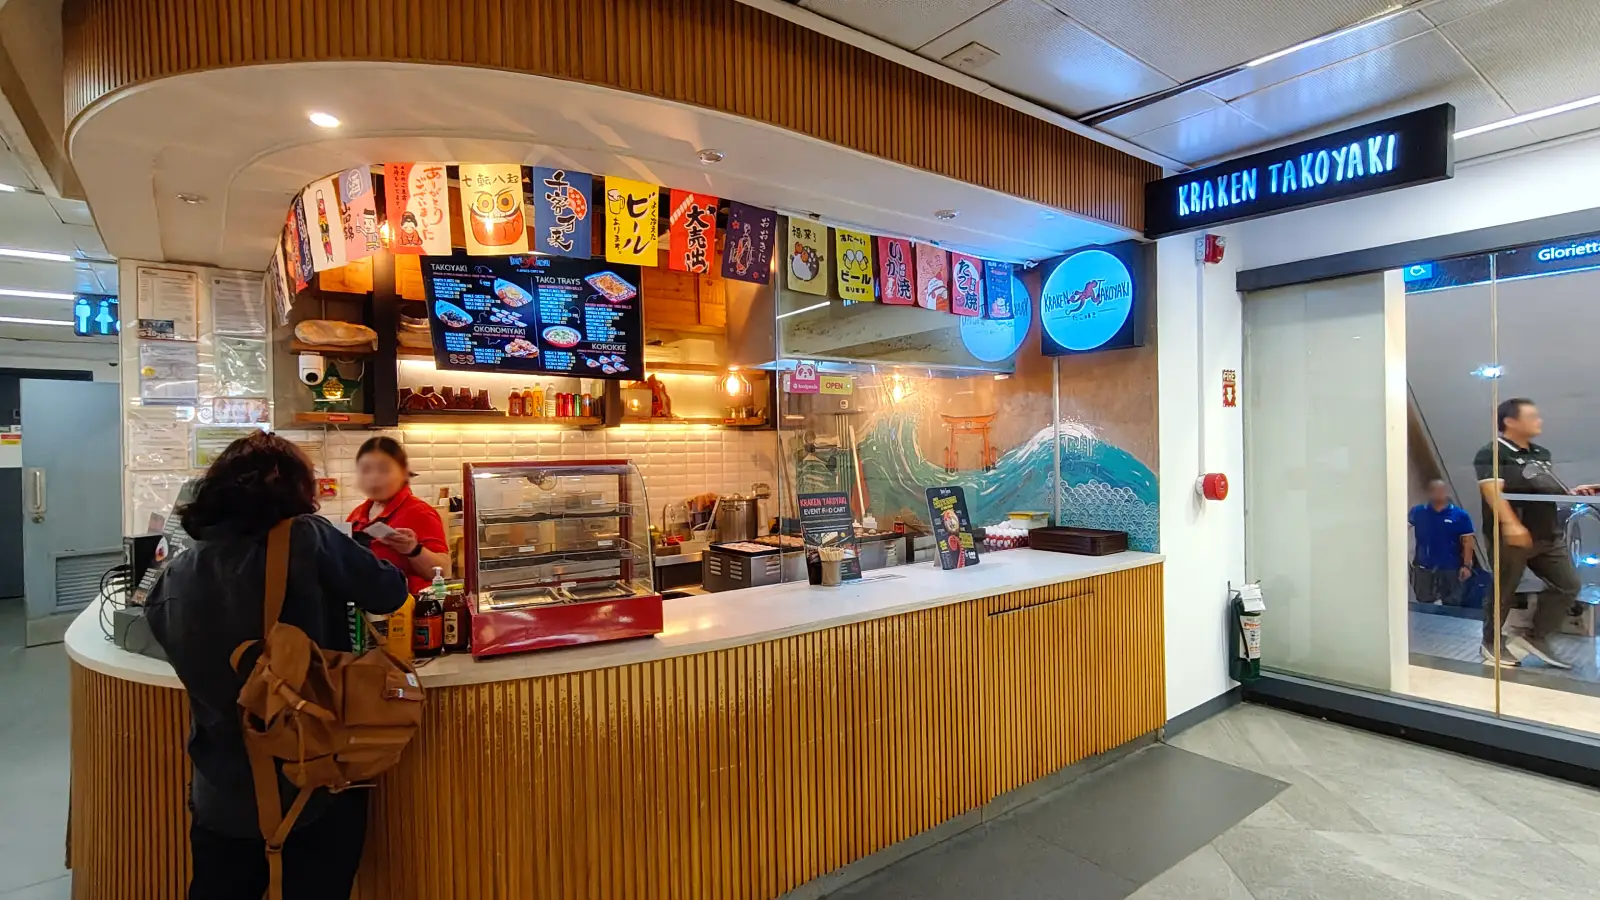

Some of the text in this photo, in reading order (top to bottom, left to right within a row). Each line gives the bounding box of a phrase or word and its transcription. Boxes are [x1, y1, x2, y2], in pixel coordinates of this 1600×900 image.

[462, 173, 519, 187] 七転八起
[1178, 134, 1397, 216] KRAKEN TAKOYAKI
[544, 170, 577, 251] 千客万来
[622, 191, 656, 256] ビール
[758, 217, 771, 263] おおきに
[1538, 240, 1600, 261] Gloriett
[430, 263, 468, 273] TAKOYAKI
[535, 276, 581, 286] TAKO TRAYS
[841, 270, 872, 285] ビール
[1043, 290, 1069, 313] KRAKEN
[1096, 279, 1130, 306] TAKOYAKI
[473, 325, 526, 336] OKONOMIYAKI
[591, 343, 627, 352] KOROKKE
[825, 382, 843, 390] OPEN
[800, 498, 821, 507] KRAKEN
